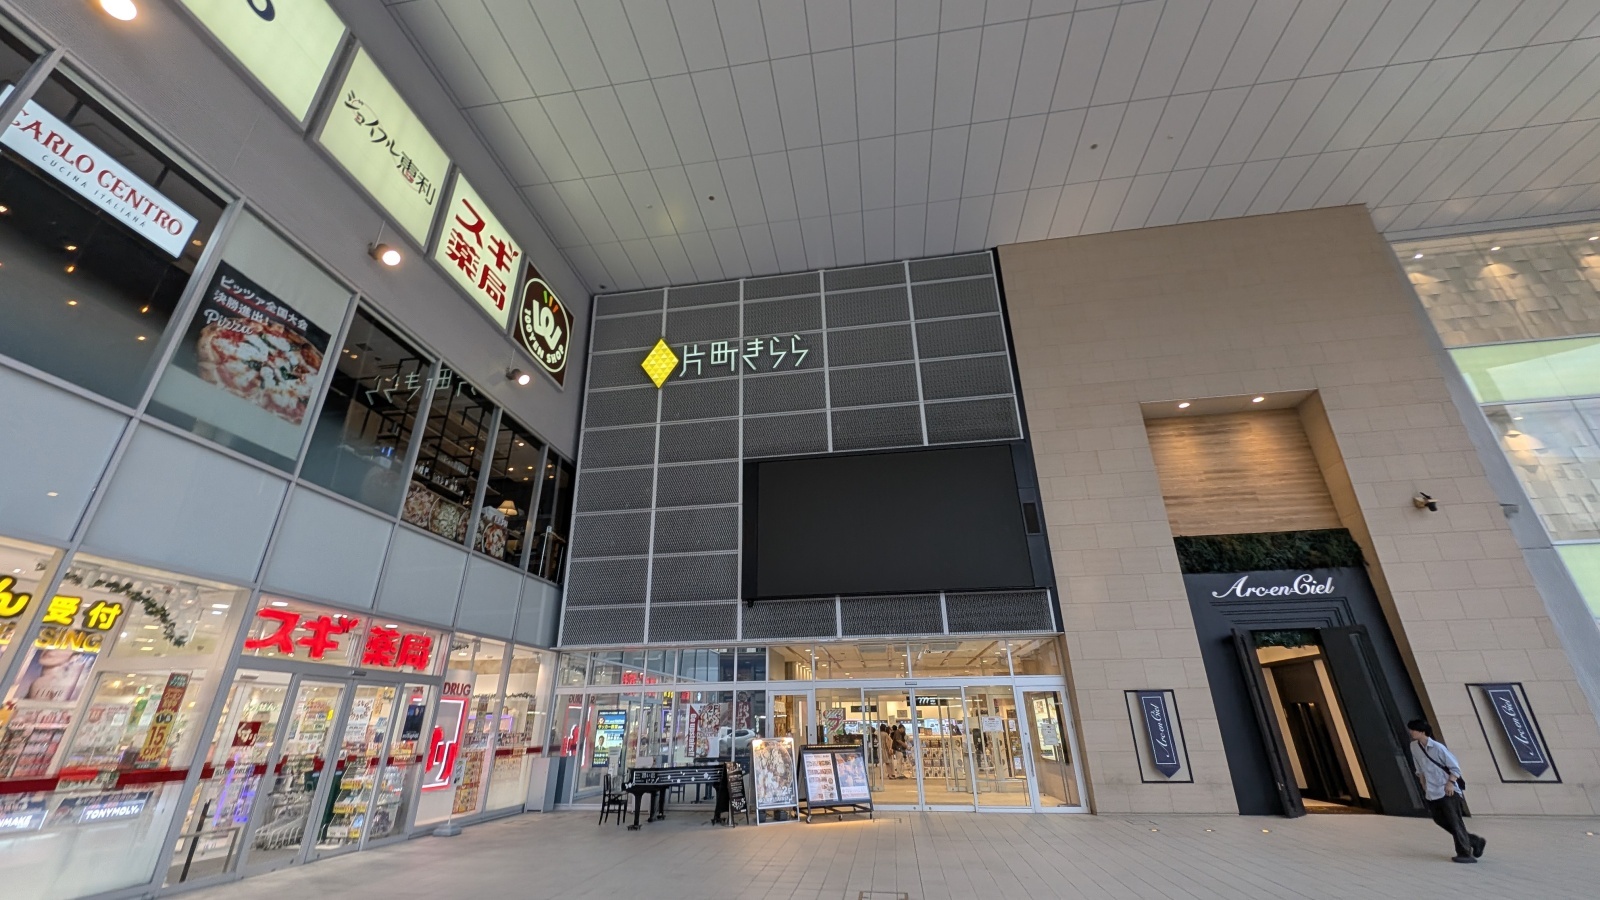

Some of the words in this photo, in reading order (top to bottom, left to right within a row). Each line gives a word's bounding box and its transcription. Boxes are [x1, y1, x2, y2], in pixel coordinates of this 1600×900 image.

[344, 90, 437, 206] ジョイフル恵利
[41, 154, 87, 189] CUCINA
[93, 190, 146, 228] ITALIANA
[97, 169, 183, 236] CENTRO
[455, 198, 519, 273] スギ
[445, 228, 507, 311] 薬局
[203, 308, 256, 335] Pizza
[213, 290, 269, 324] 決勝進出!
[220, 275, 308, 331] ピッツァ全国大会
[546, 344, 564, 364] SHOP
[679, 334, 809, 377] 片町きらら
[443, 682, 471, 697] DRUG
[85, 805, 139, 820] TONYMOLY
